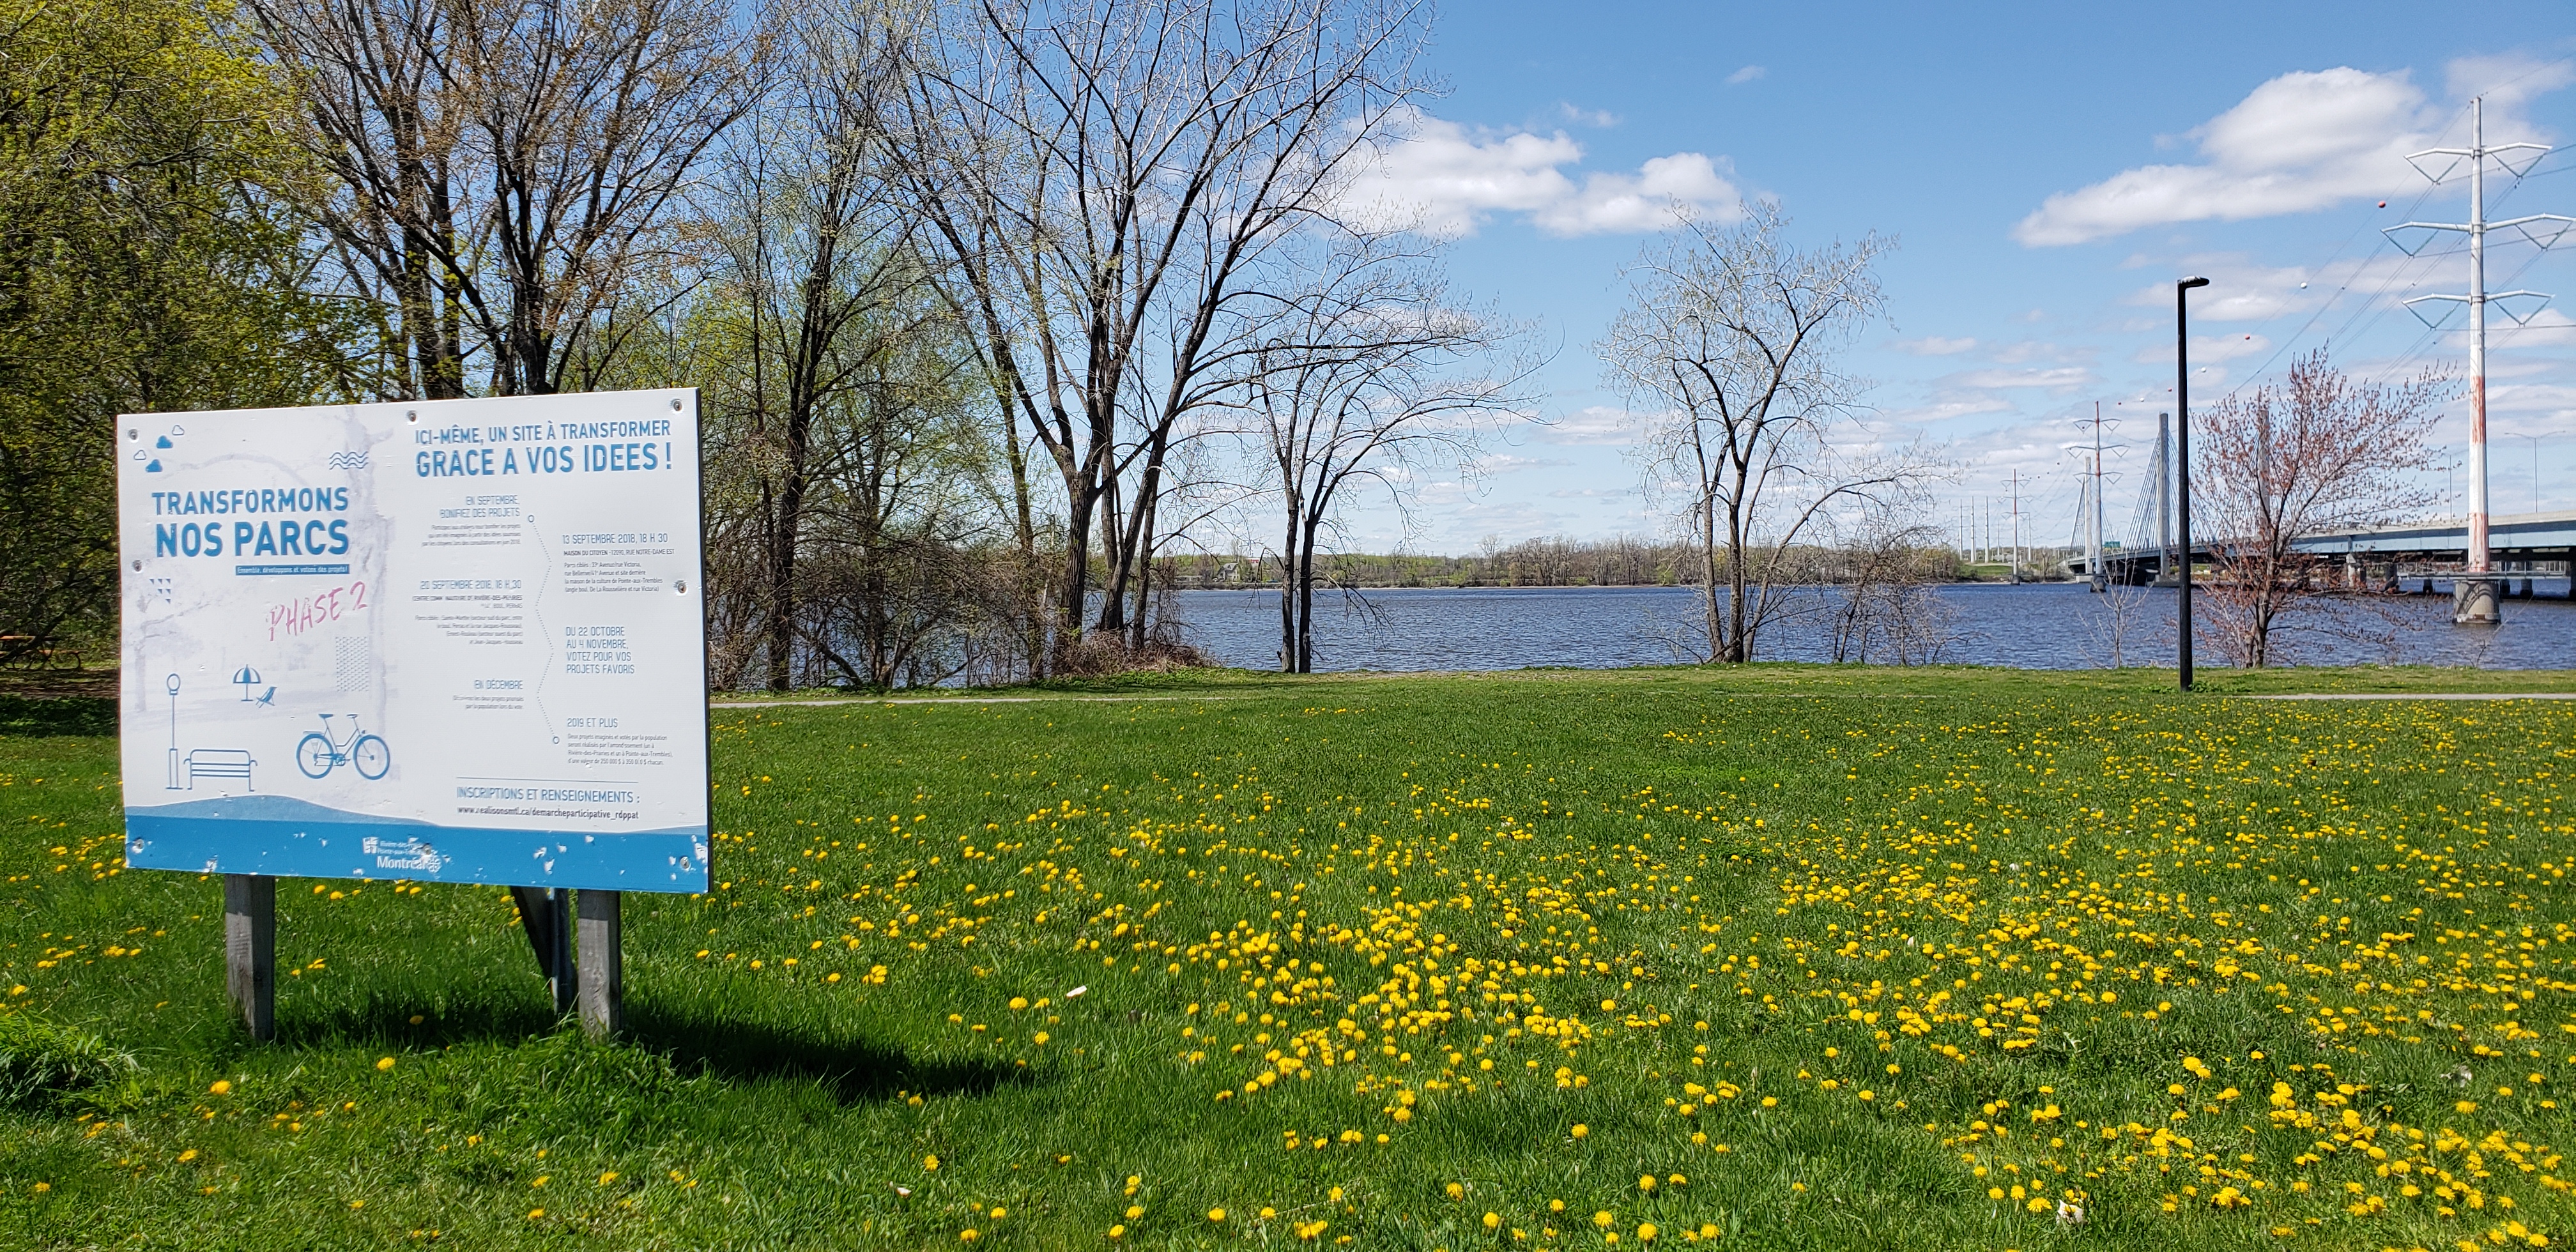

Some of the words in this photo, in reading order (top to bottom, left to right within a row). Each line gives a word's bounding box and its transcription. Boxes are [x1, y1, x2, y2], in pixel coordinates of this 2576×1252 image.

[416, 424, 484, 446] ICI-MÊME,
[489, 426, 507, 442] UN
[512, 425, 542, 441] SITE
[547, 421, 556, 440] À
[560, 420, 671, 439] TRANSFORMER
[417, 448, 494, 477] GRACE
[503, 448, 519, 475] A
[526, 445, 574, 473] VOS
[584, 443, 658, 471] IDEES
[151, 487, 349, 515] TRANSFORMONS
[466, 496, 475, 505] EN
[473, 508, 486, 517] DES
[488, 507, 520, 517] PROJETS
[156, 522, 223, 558] NOS
[234, 519, 349, 556] PARCS
[562, 535, 570, 544] 13
[572, 534, 616, 544] SEPTEMBRE
[618, 534, 638, 544] 2018,
[640, 533, 647, 543] 18
[650, 533, 656, 542] H
[658, 533, 668, 542] 30
[420, 581, 430, 590] 20
[432, 580, 473, 589] SEPTEMBRE
[495, 580, 503, 589] 18
[505, 580, 510, 589] H
[512, 579, 521, 589] 30
[268, 586, 344, 641] PHASE
[349, 581, 367, 611] 2
[566, 627, 576, 636] DU
[578, 627, 588, 636] 22
[591, 626, 625, 636] OCTOBRE
[566, 639, 576, 649] AU
[579, 639, 584, 648] 4
[586, 639, 629, 649] NOVEMBRE,
[567, 652, 591, 661] VOTEZ
[594, 652, 613, 661] POUR
[616, 652, 631, 661] VOS
[567, 664, 601, 674] PROJETS
[602, 664, 635, 674] FAVORIS
[475, 680, 484, 689] EN
[486, 678, 523, 689] DÉCEMBRE
[567, 717, 584, 728] 2019
[586, 717, 597, 728] ET
[599, 718, 618, 728] PLUS
[457, 786, 523, 800] INSCRIPTIONS
[526, 788, 538, 800] ET
[541, 789, 633, 803] RENSEIGNEMENTS
[377, 855, 426, 869] Montréal
